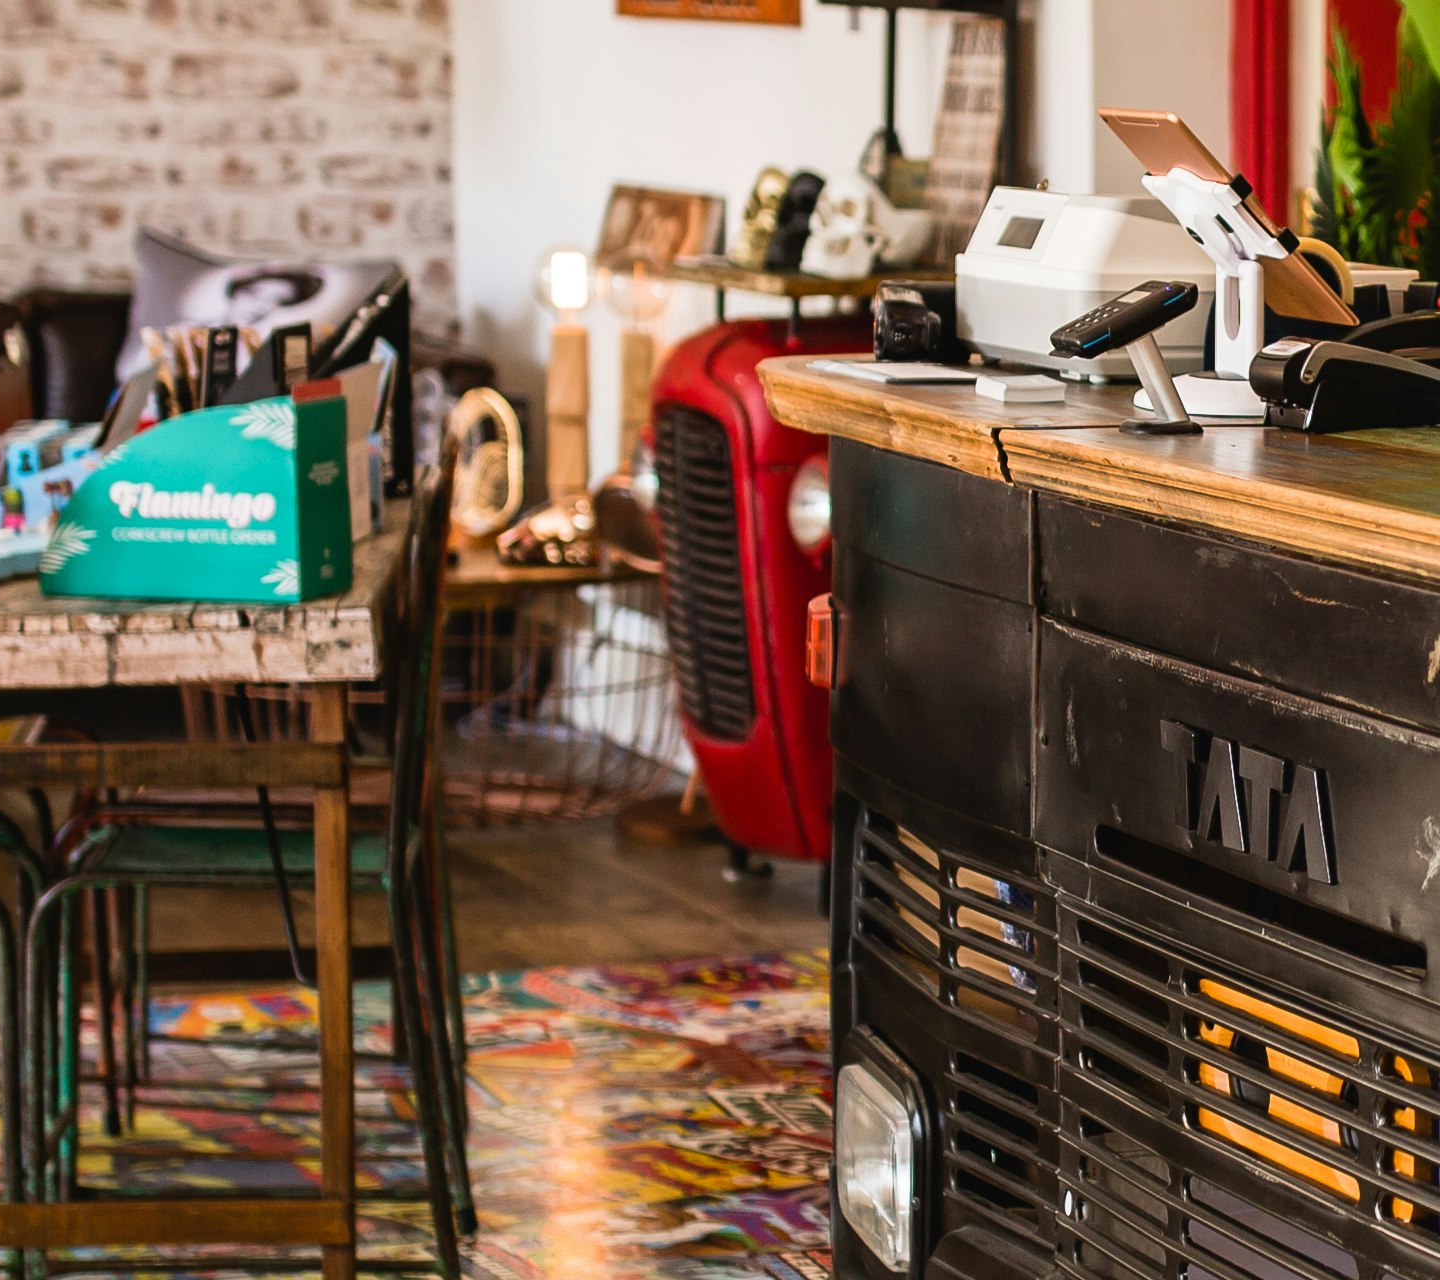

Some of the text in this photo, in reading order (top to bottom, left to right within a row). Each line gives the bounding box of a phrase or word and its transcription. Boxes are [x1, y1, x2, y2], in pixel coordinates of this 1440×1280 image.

[110, 480, 277, 529] Flamingo
[111, 526, 277, 546] CORKSCREW BOTTLE OPENER
[1160, 719, 1340, 886] TATA
